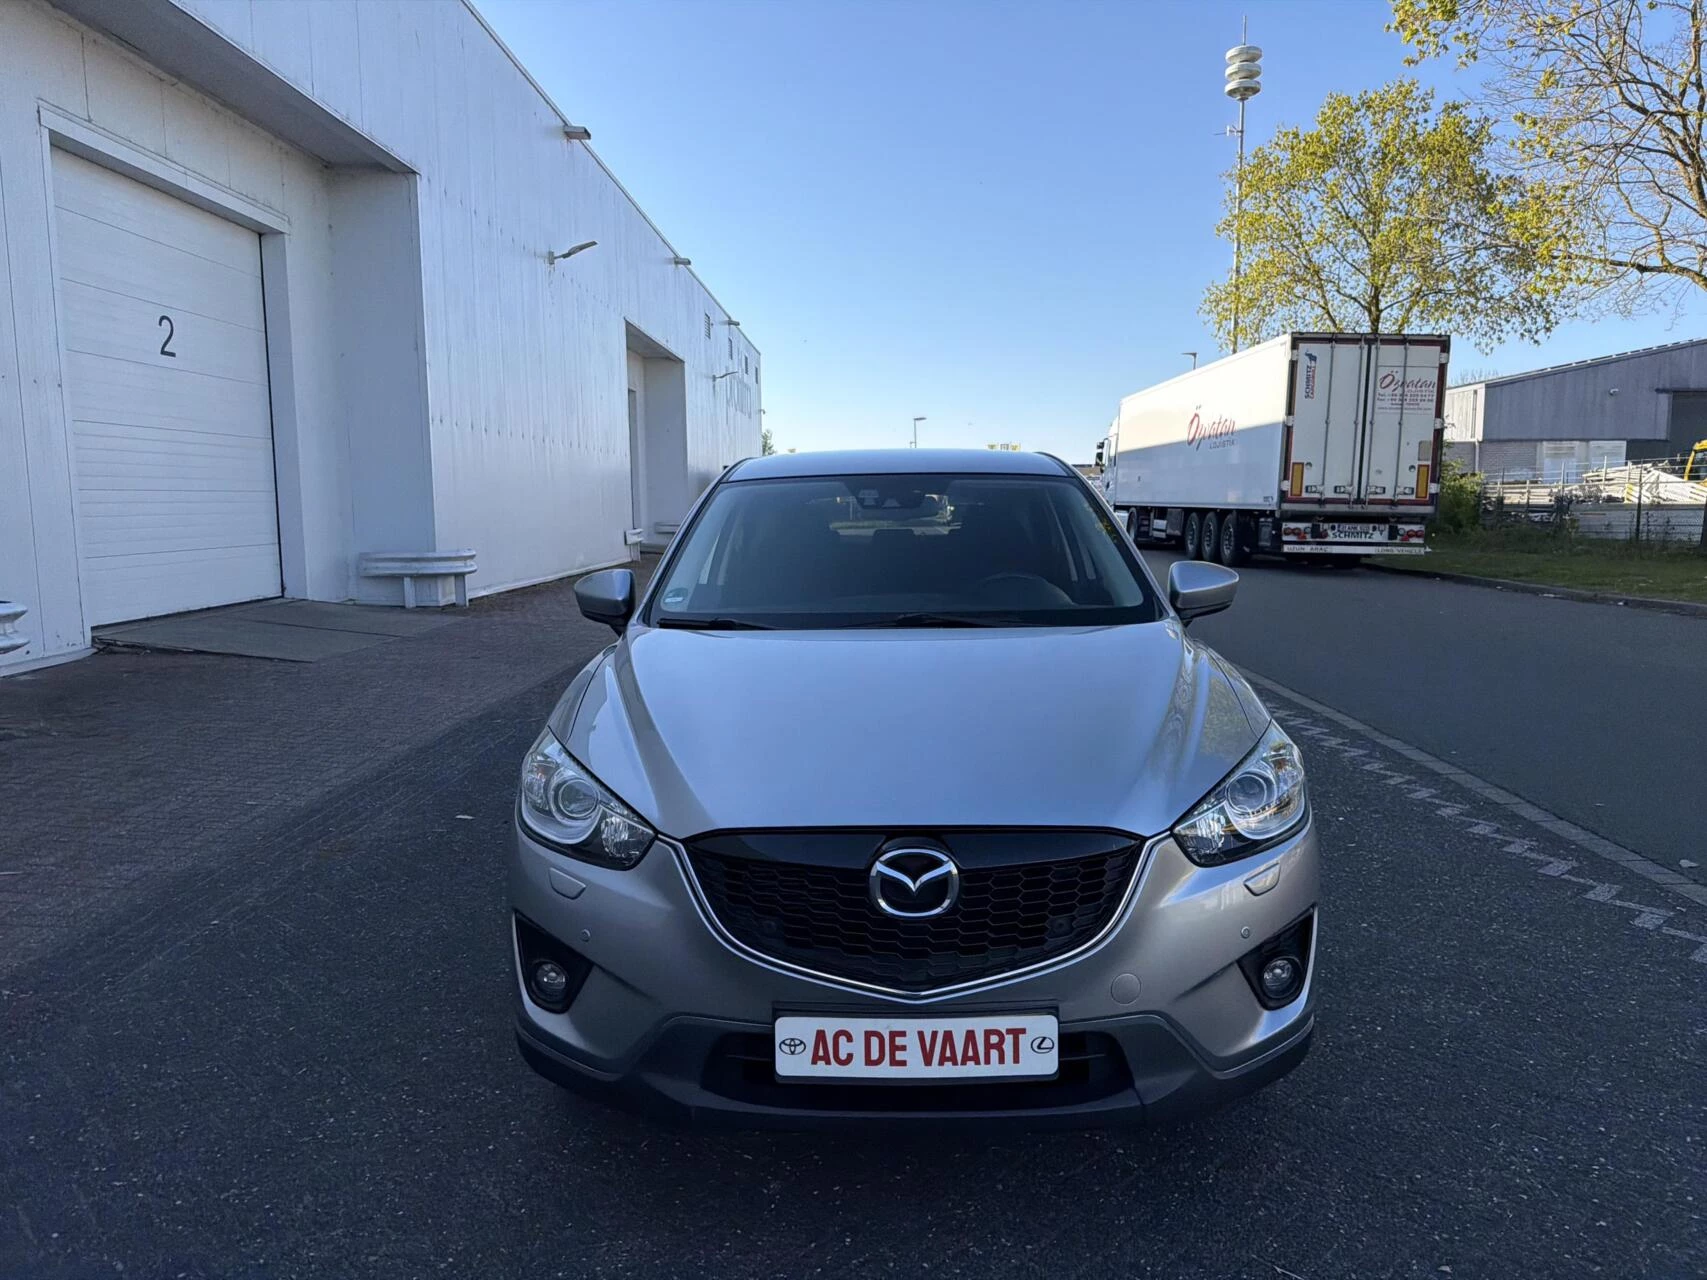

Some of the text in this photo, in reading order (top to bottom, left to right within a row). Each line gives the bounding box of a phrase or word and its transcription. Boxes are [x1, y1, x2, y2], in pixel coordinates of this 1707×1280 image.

[158, 315, 176, 357] 2
[1304, 364, 1312, 399] SCHMITZ
[1331, 530, 1374, 540] SCHMITZ
[811, 1028, 1026, 1067] AC DE VAART
